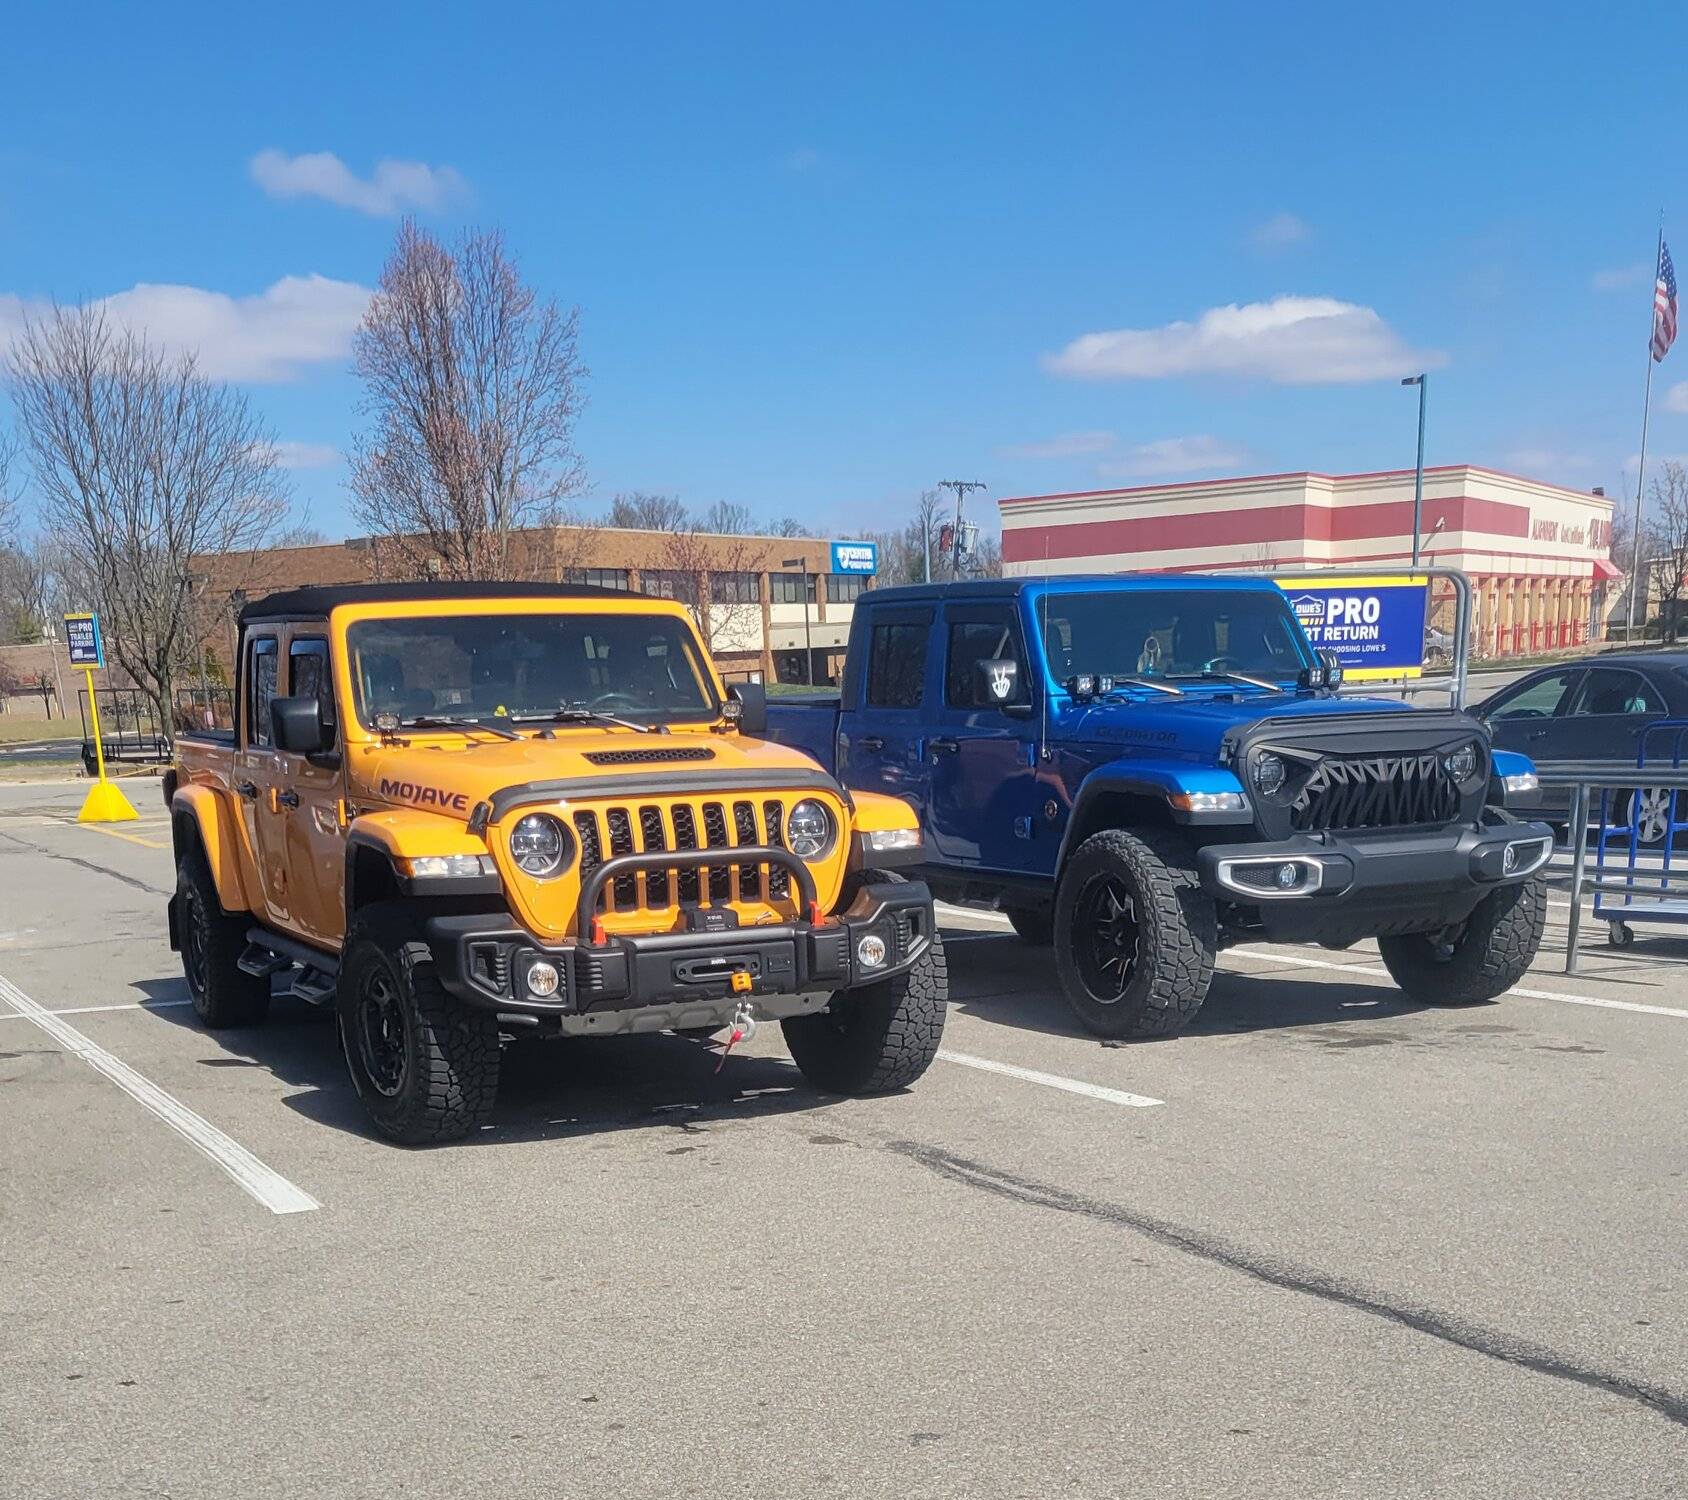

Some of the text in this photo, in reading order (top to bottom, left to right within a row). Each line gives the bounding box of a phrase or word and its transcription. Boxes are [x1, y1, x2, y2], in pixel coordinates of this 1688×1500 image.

[1293, 602, 1322, 614] OWE'S
[1326, 597, 1381, 625] PRO
[78, 622, 93, 632] PRO
[70, 632, 94, 641] TRAILER
[1323, 625, 1379, 641] RETURN
[70, 640, 95, 648] PARKING
[1361, 644, 1386, 653] LOWE'S
[380, 778, 470, 811] MOJAVE
